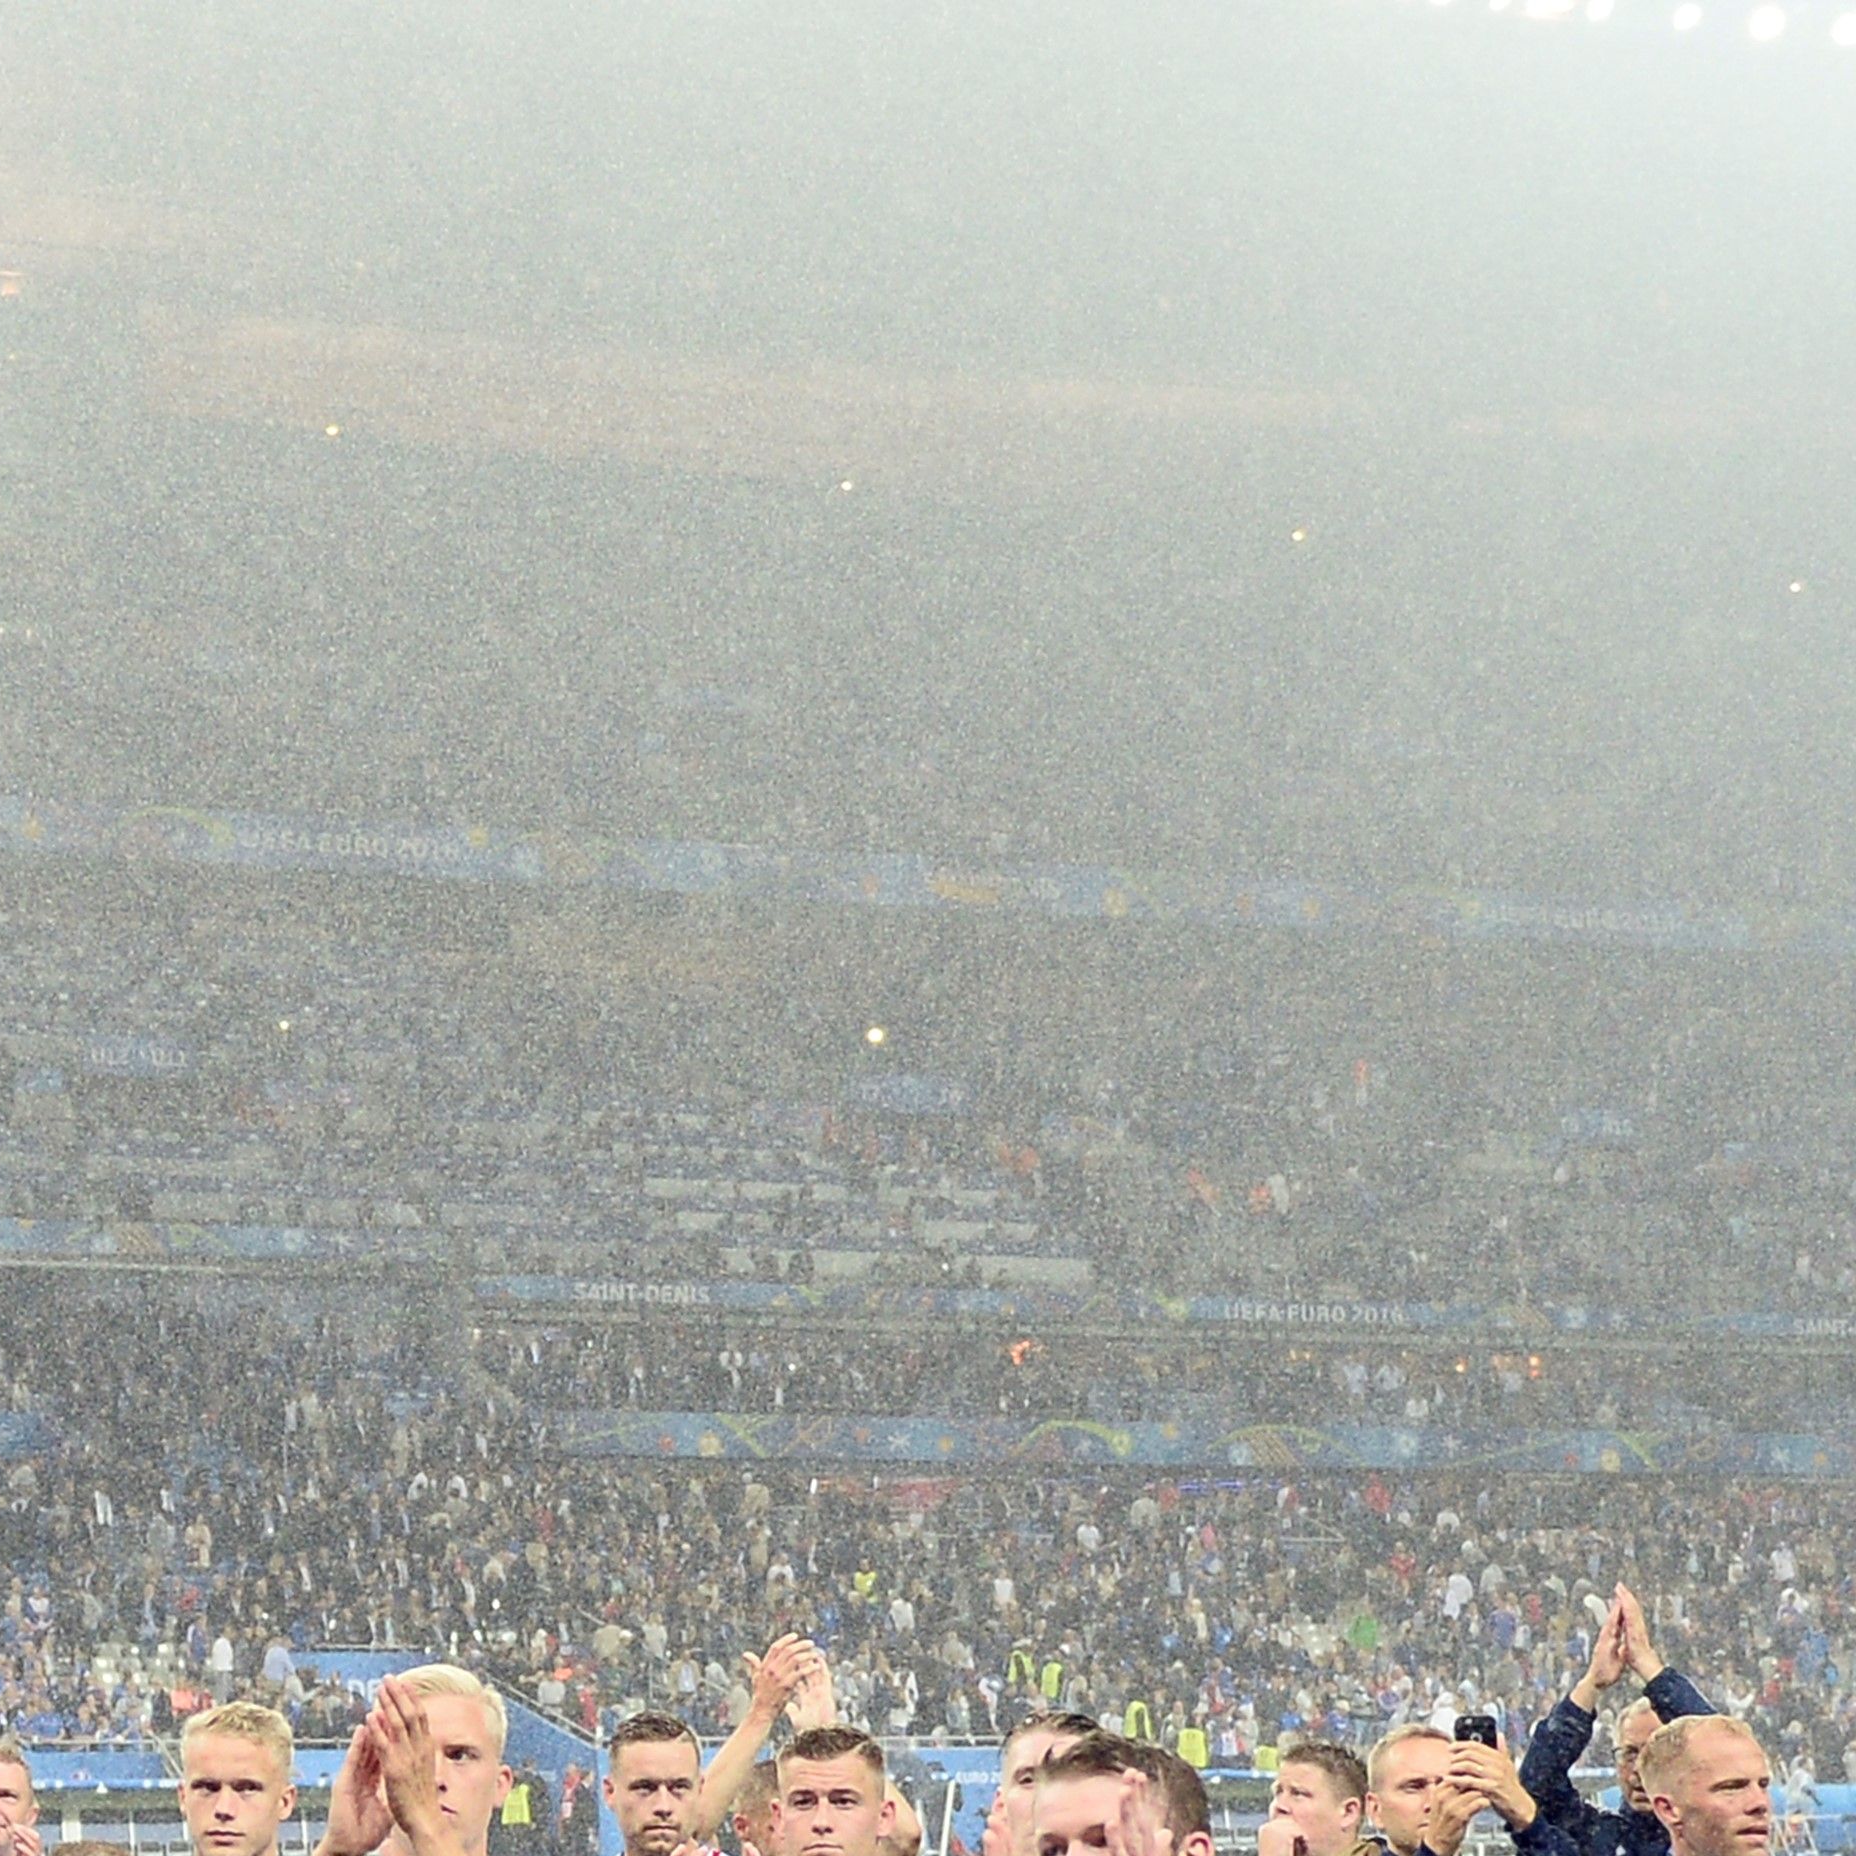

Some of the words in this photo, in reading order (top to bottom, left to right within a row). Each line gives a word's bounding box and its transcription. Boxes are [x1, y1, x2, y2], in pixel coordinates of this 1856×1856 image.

[574, 1281, 711, 1305] SAINT-DENIS
[1224, 1302, 1280, 1321] UEFA
[1287, 1304, 1346, 1323] EURO
[1352, 1306, 1405, 1325] 2016
